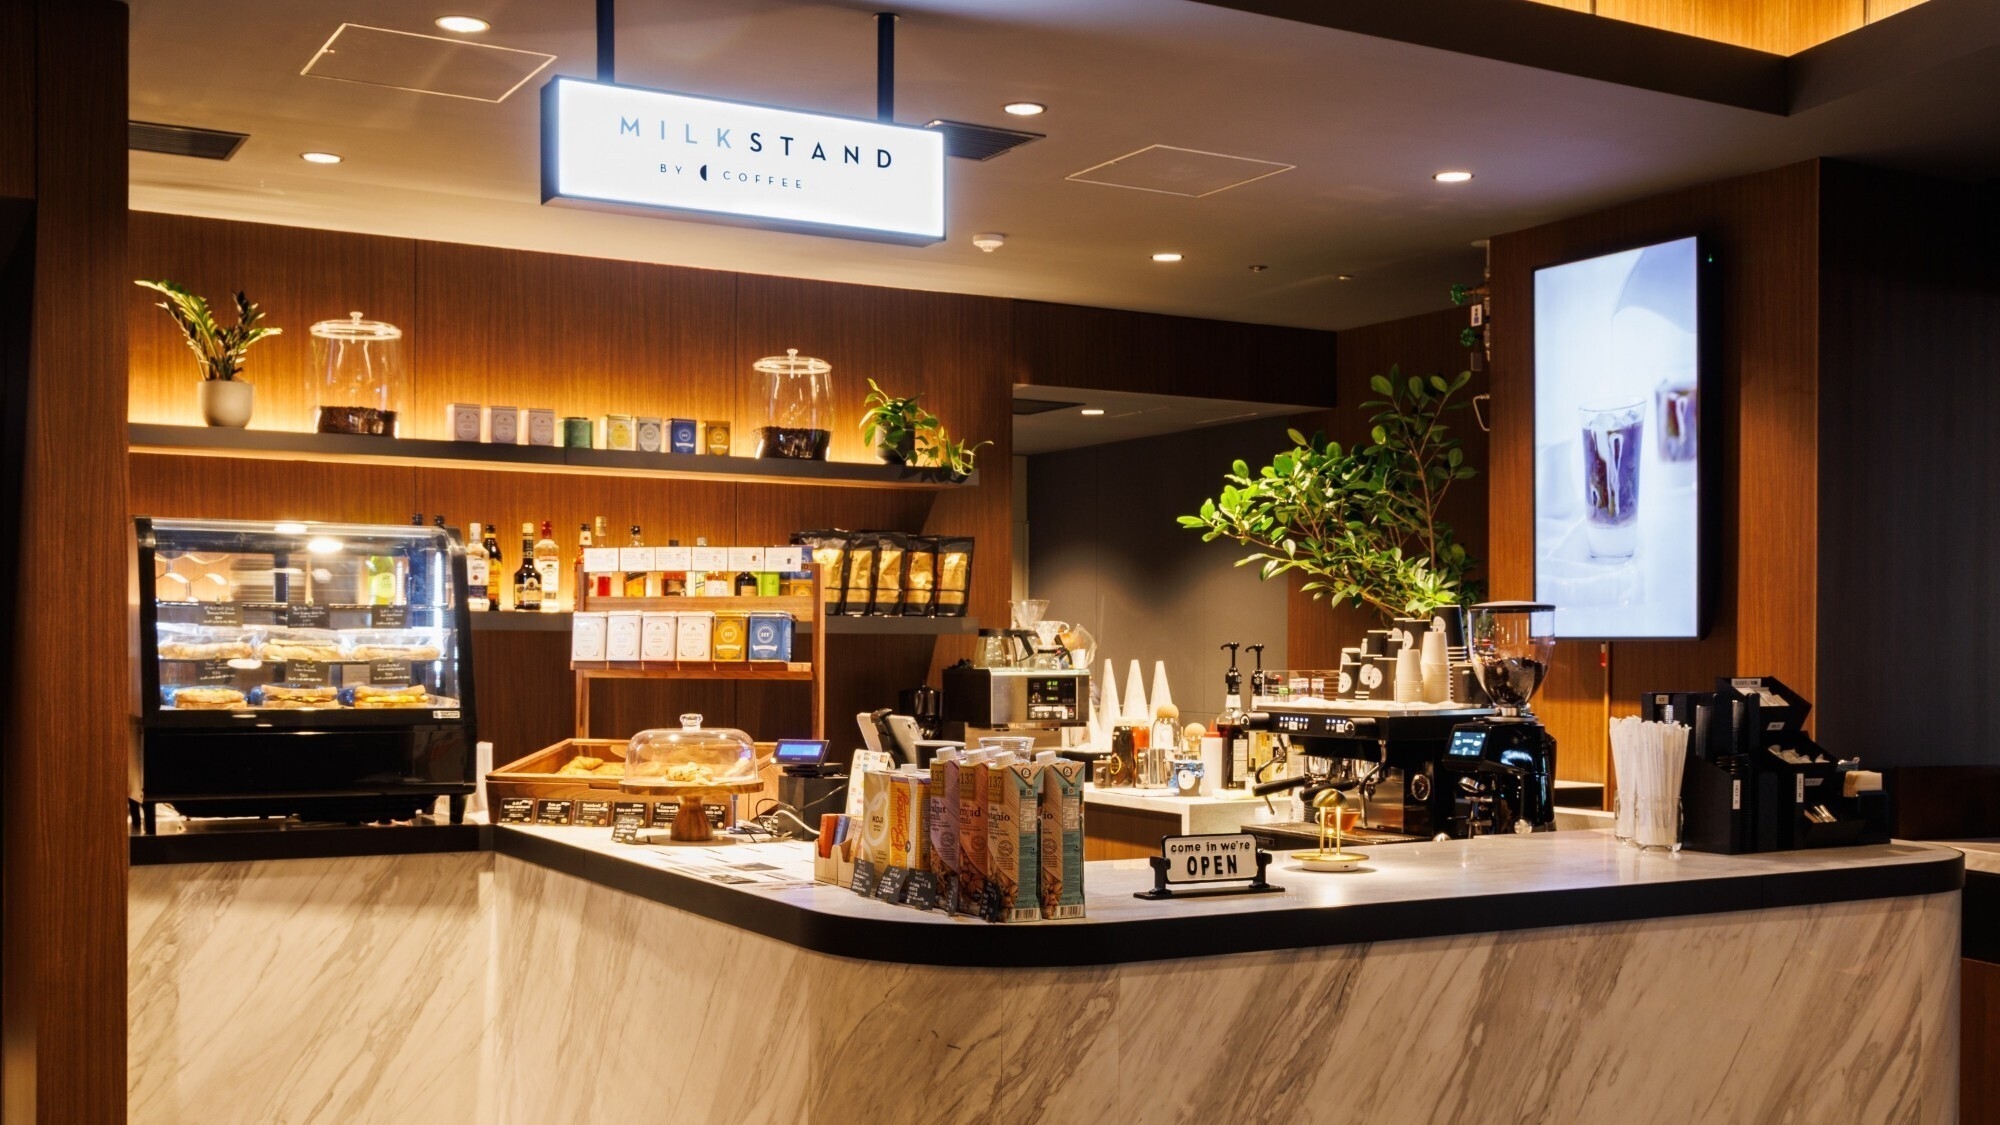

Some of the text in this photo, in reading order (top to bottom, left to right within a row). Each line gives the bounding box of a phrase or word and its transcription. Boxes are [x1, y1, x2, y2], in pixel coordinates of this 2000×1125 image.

[660, 163, 802, 189] BY COFFEE
[960, 773, 974, 785] 137
[1170, 840, 1251, 853] come in we're
[1187, 855, 1238, 876] OPEN
